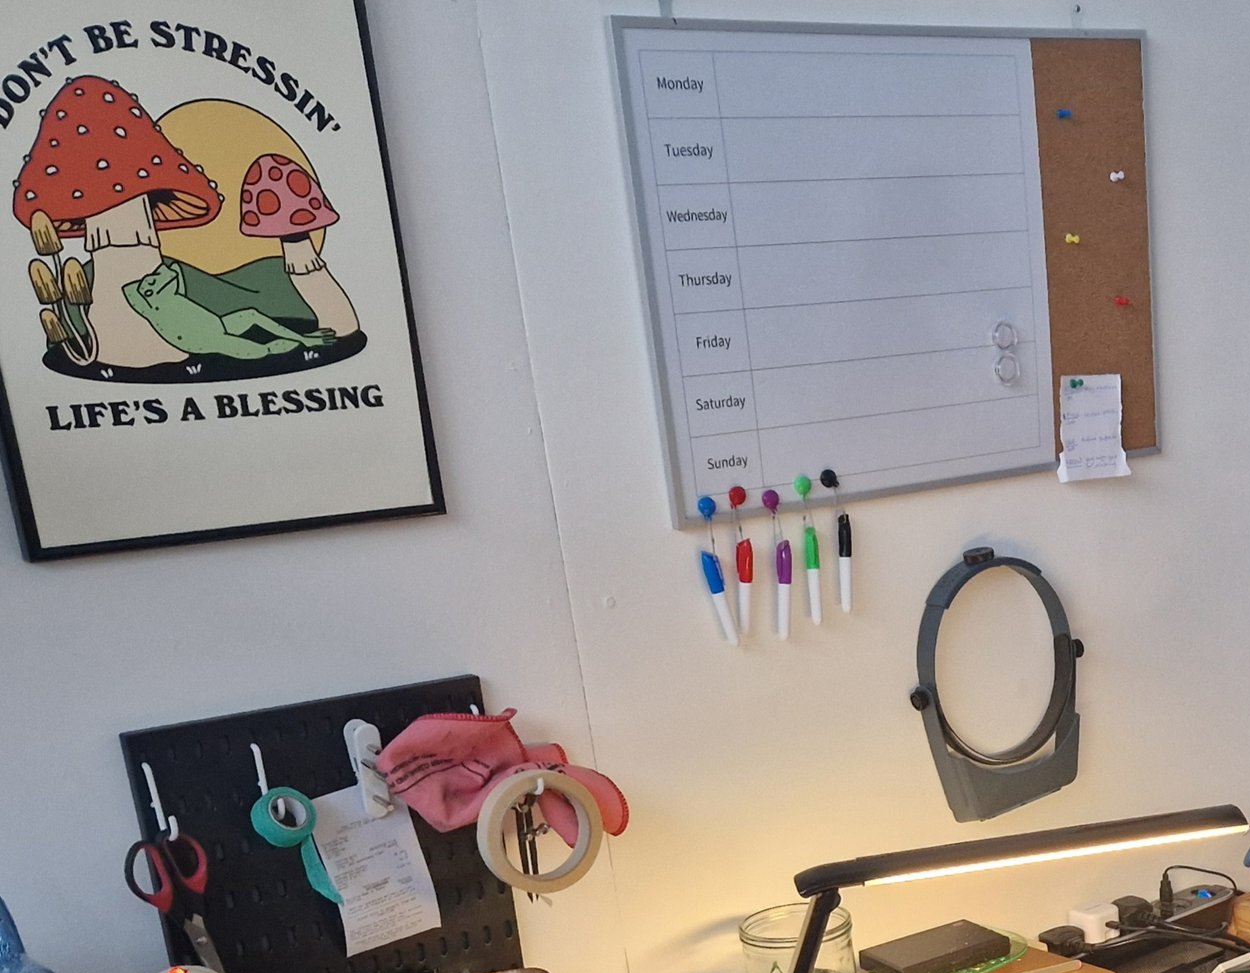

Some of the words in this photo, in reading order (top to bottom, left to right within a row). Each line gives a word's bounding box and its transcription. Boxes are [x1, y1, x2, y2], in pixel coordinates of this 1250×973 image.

[0, 34, 77, 130] DON'T
[83, 20, 139, 53] BE
[150, 20, 341, 133] STRESSIN'
[656, 75, 704, 93] Monday
[664, 142, 714, 160] Tuesday
[666, 207, 728, 224] Wednesday
[678, 271, 732, 288] Thursday
[695, 335, 732, 351] Friday
[46, 398, 168, 431] LIFE'S
[180, 397, 206, 421] A
[214, 384, 385, 419] BLESSING
[695, 394, 746, 411] Saturday
[707, 454, 749, 470] Sunday
